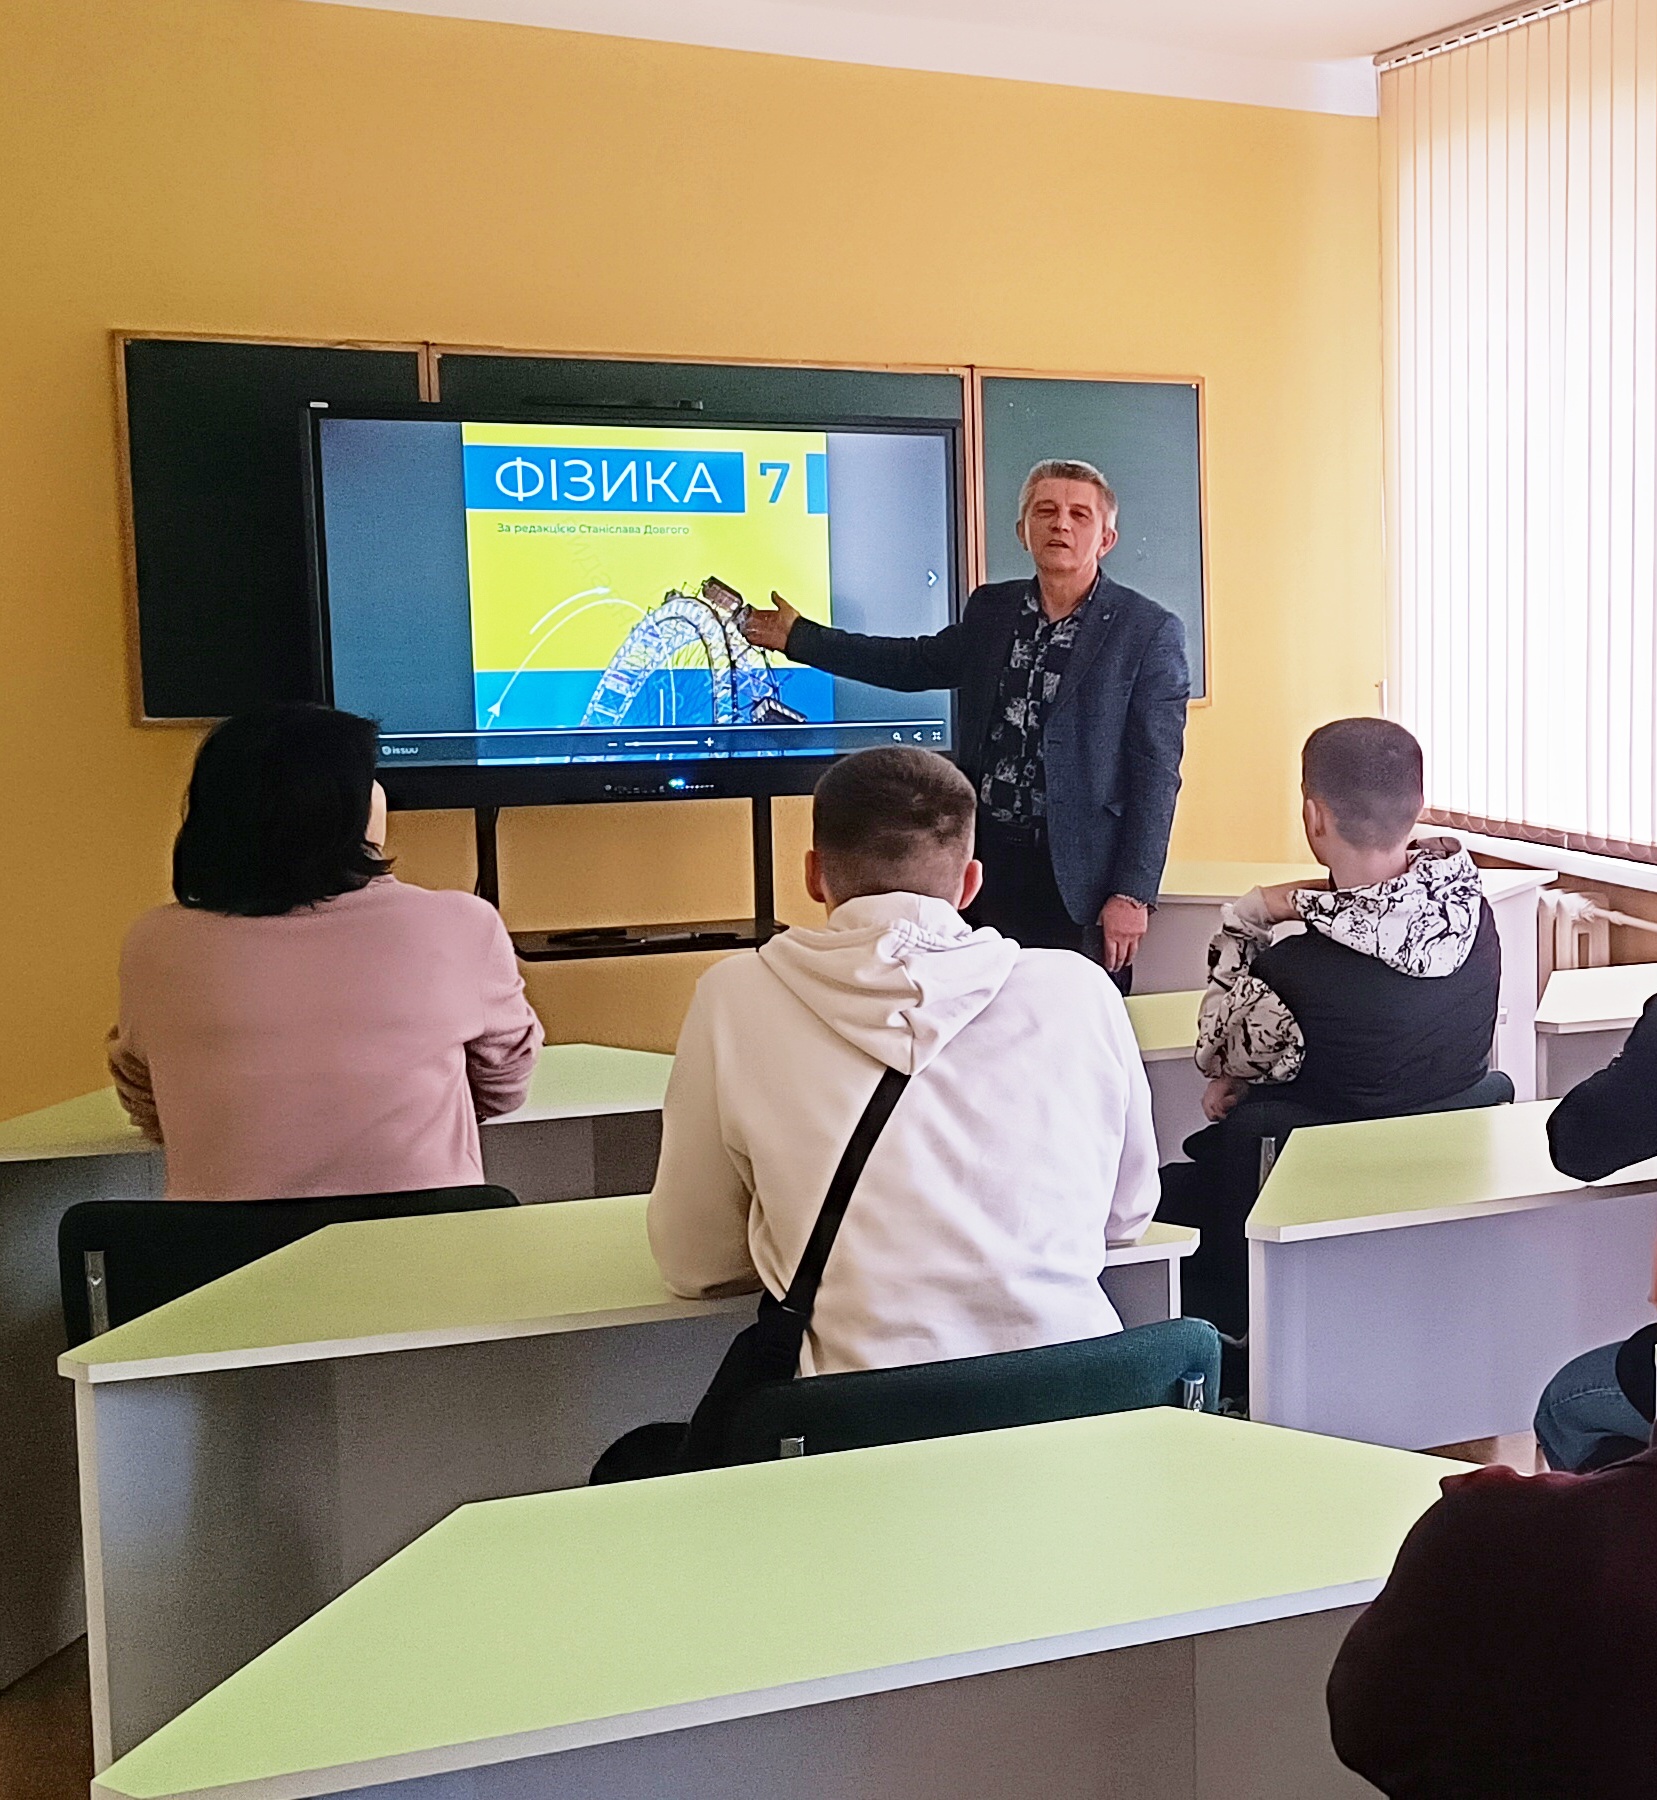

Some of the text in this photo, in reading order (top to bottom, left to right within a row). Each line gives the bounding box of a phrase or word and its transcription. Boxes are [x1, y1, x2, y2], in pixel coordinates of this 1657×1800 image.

[494, 456, 791, 504] ФІЗИКА 7
[497, 522, 690, 537] За редакцією Станіслава Довгого
